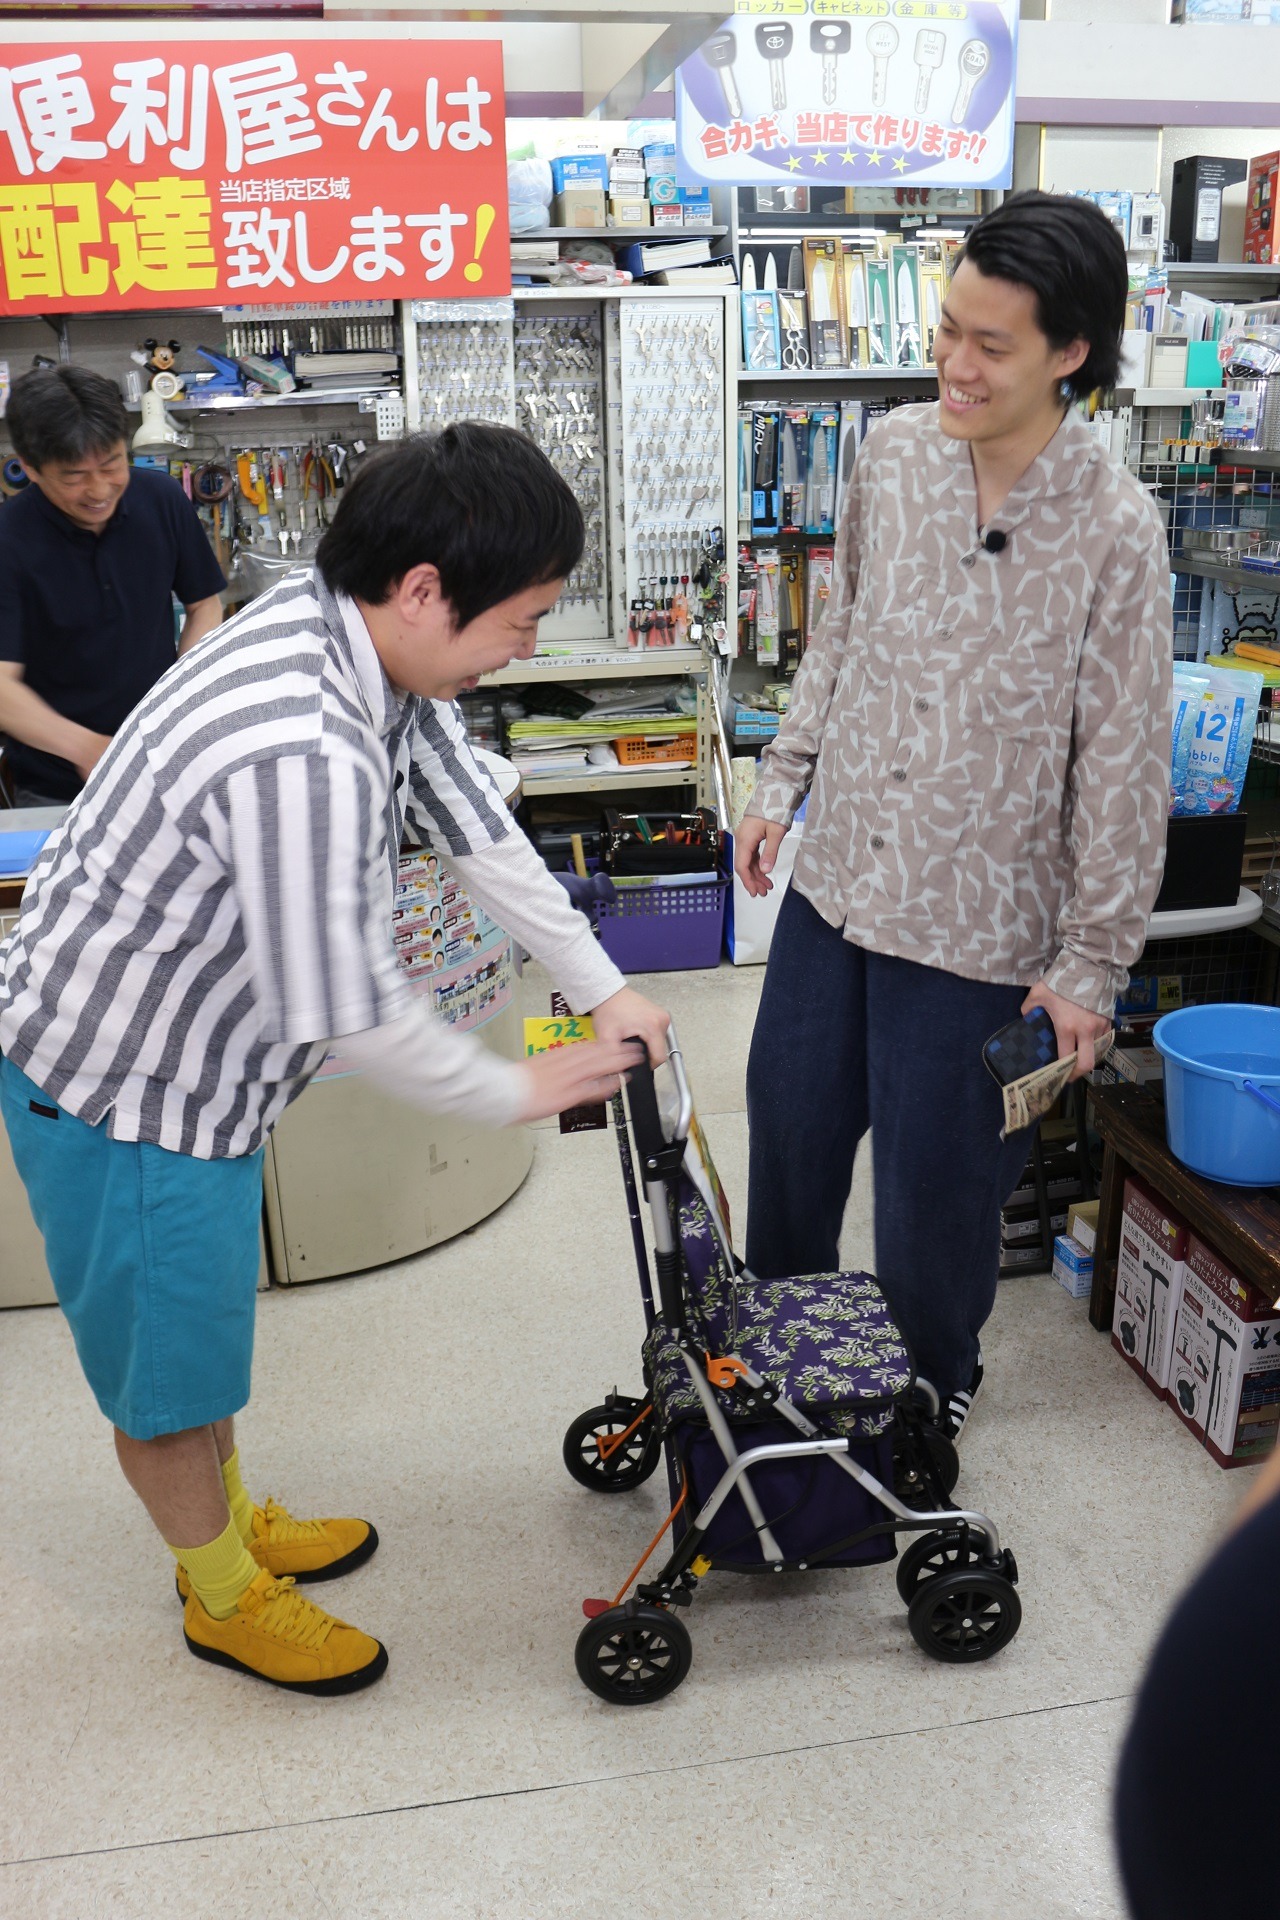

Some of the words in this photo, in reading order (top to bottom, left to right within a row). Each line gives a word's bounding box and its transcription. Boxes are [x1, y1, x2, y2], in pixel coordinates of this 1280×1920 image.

[816, 0, 885, 14] キャビネット
[965, 53, 983, 65] GOAL
[0, 51, 493, 175] 便利屋さんは
[700, 112, 986, 165] 合カギ、当店で作ります!!
[219, 176, 351, 203] 当店指定区域
[0, 176, 219, 300] 配達
[221, 203, 496, 289] 致します!
[542, 1018, 584, 1038] つえ
[1127, 1202, 1172, 1251] 折りたたみステッキ
[1189, 1256, 1241, 1311] 折りたたみステッキ
